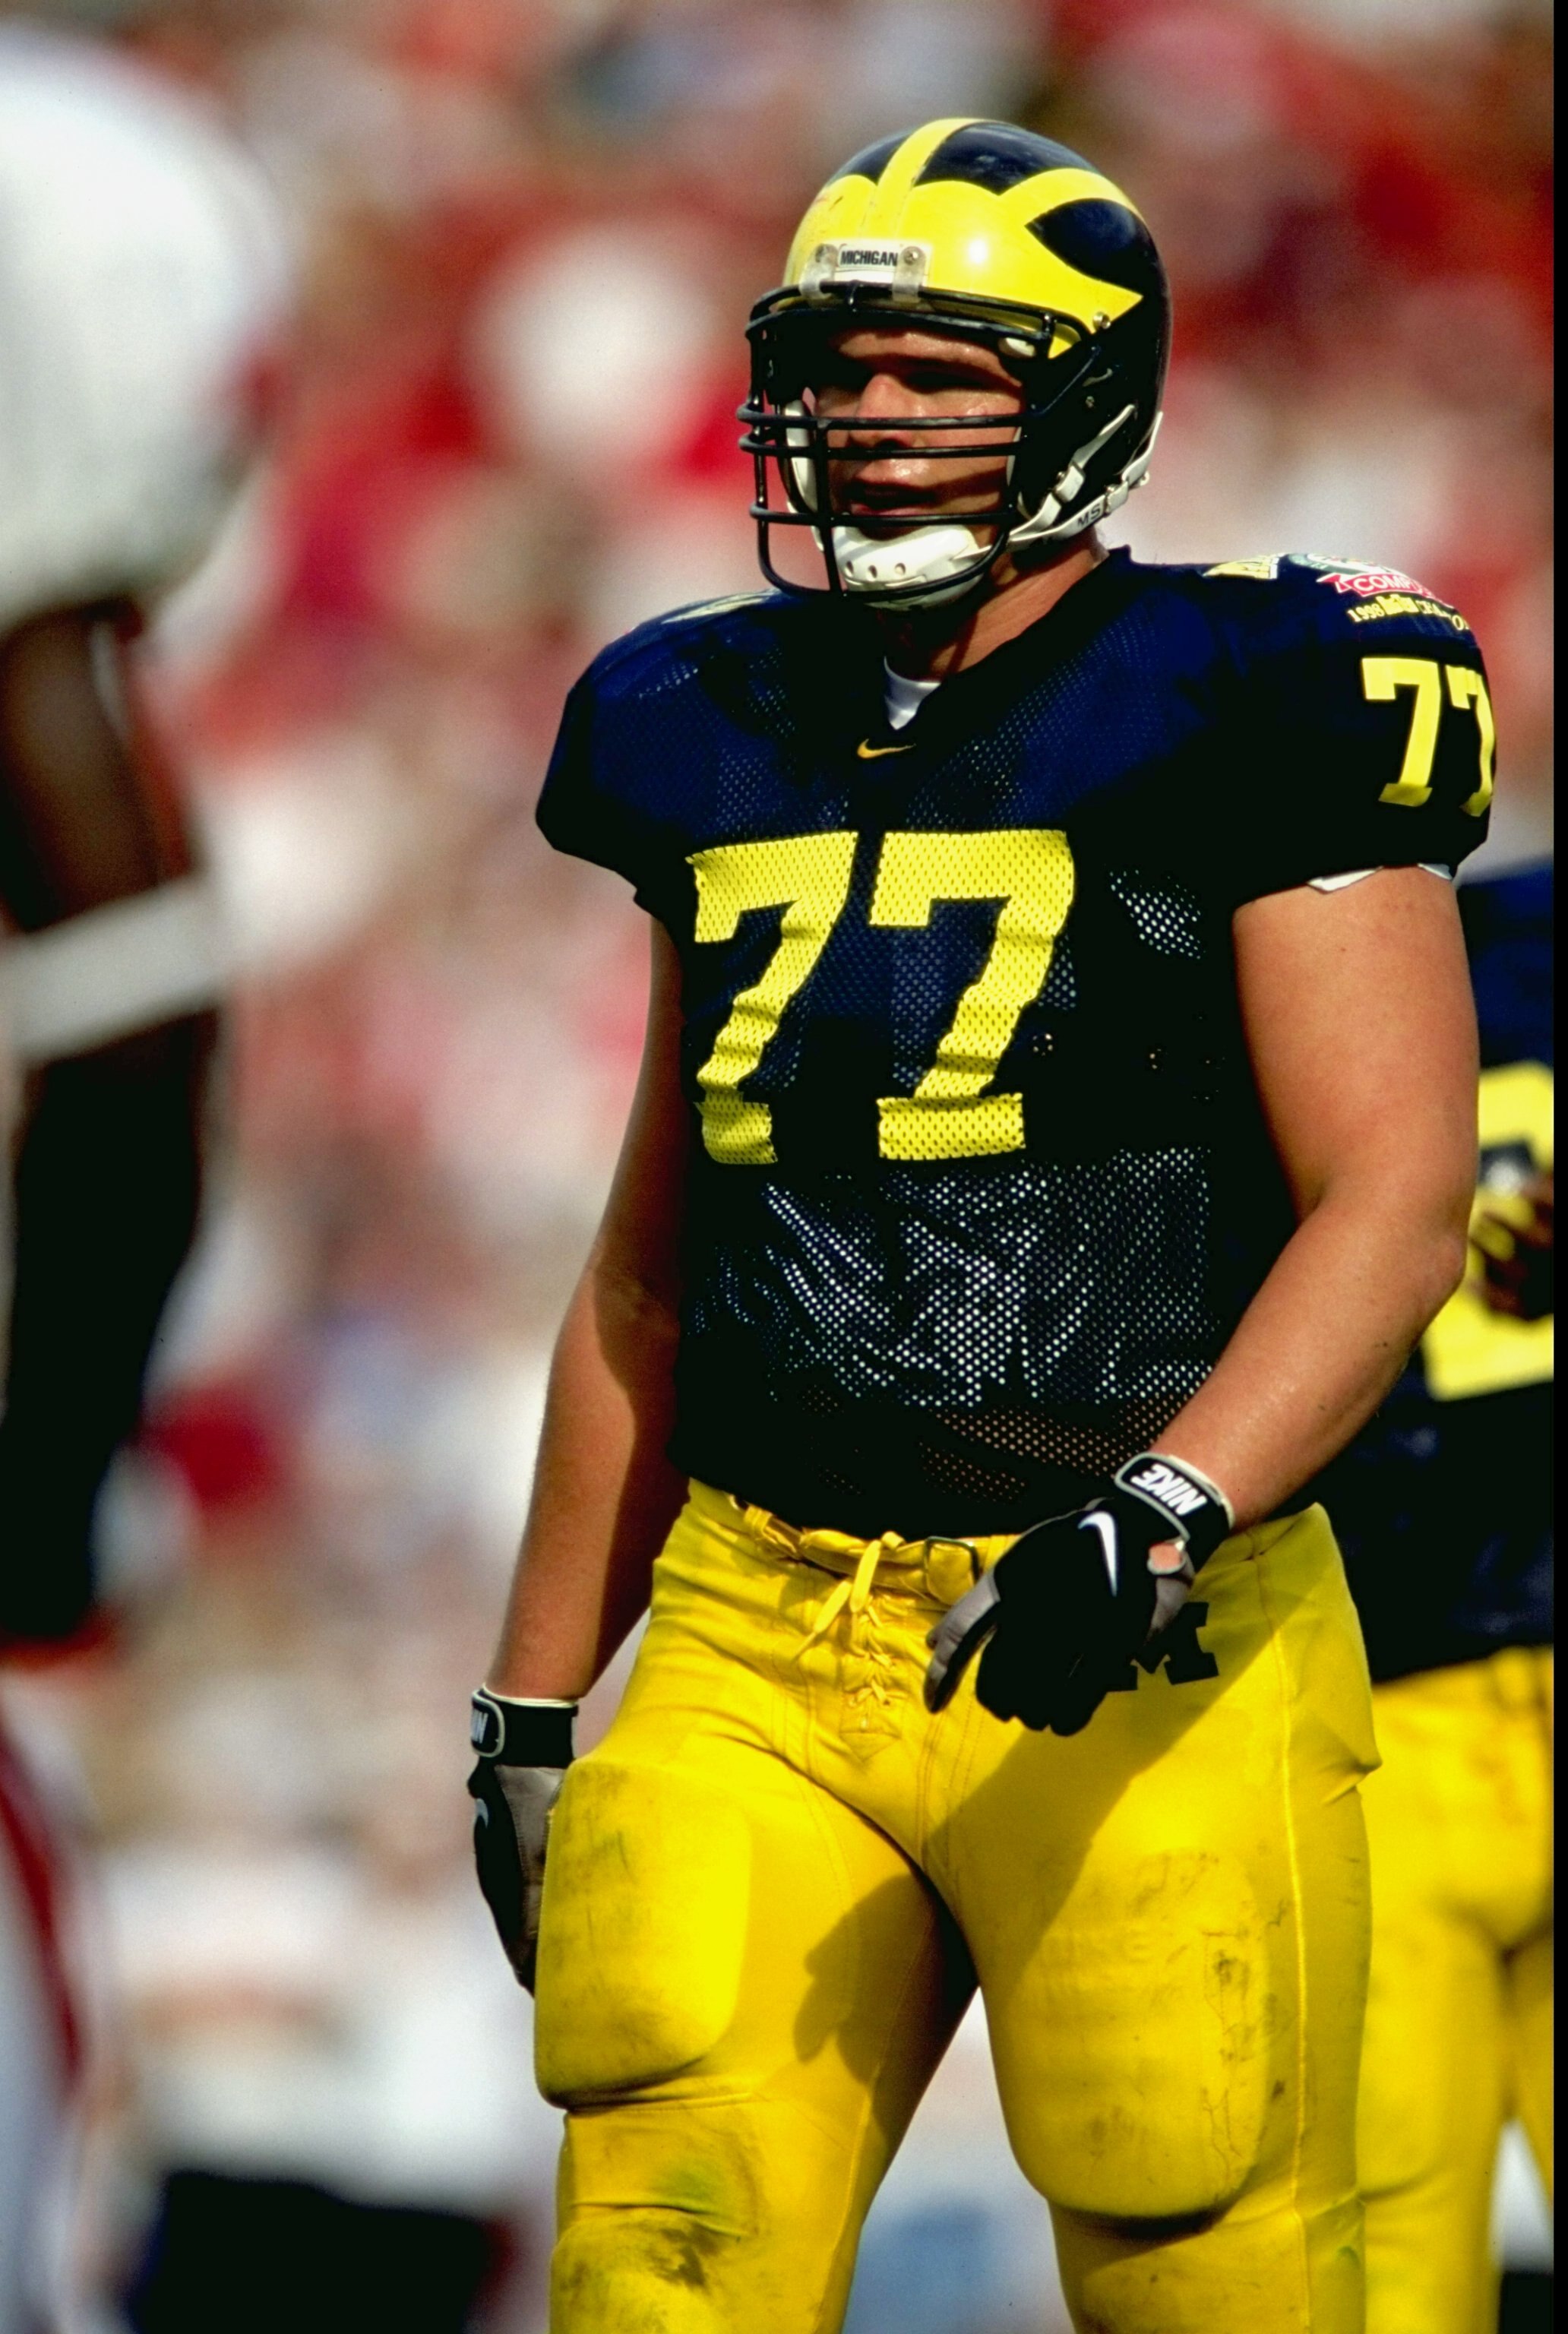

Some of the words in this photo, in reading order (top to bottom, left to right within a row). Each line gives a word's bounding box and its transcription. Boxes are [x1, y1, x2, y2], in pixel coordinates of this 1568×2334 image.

[840, 250, 899, 267] MICHIGAN
[1361, 657, 1496, 818] 77
[685, 829, 1075, 1165] 77
[1130, 1463, 1209, 1516] NIKE
